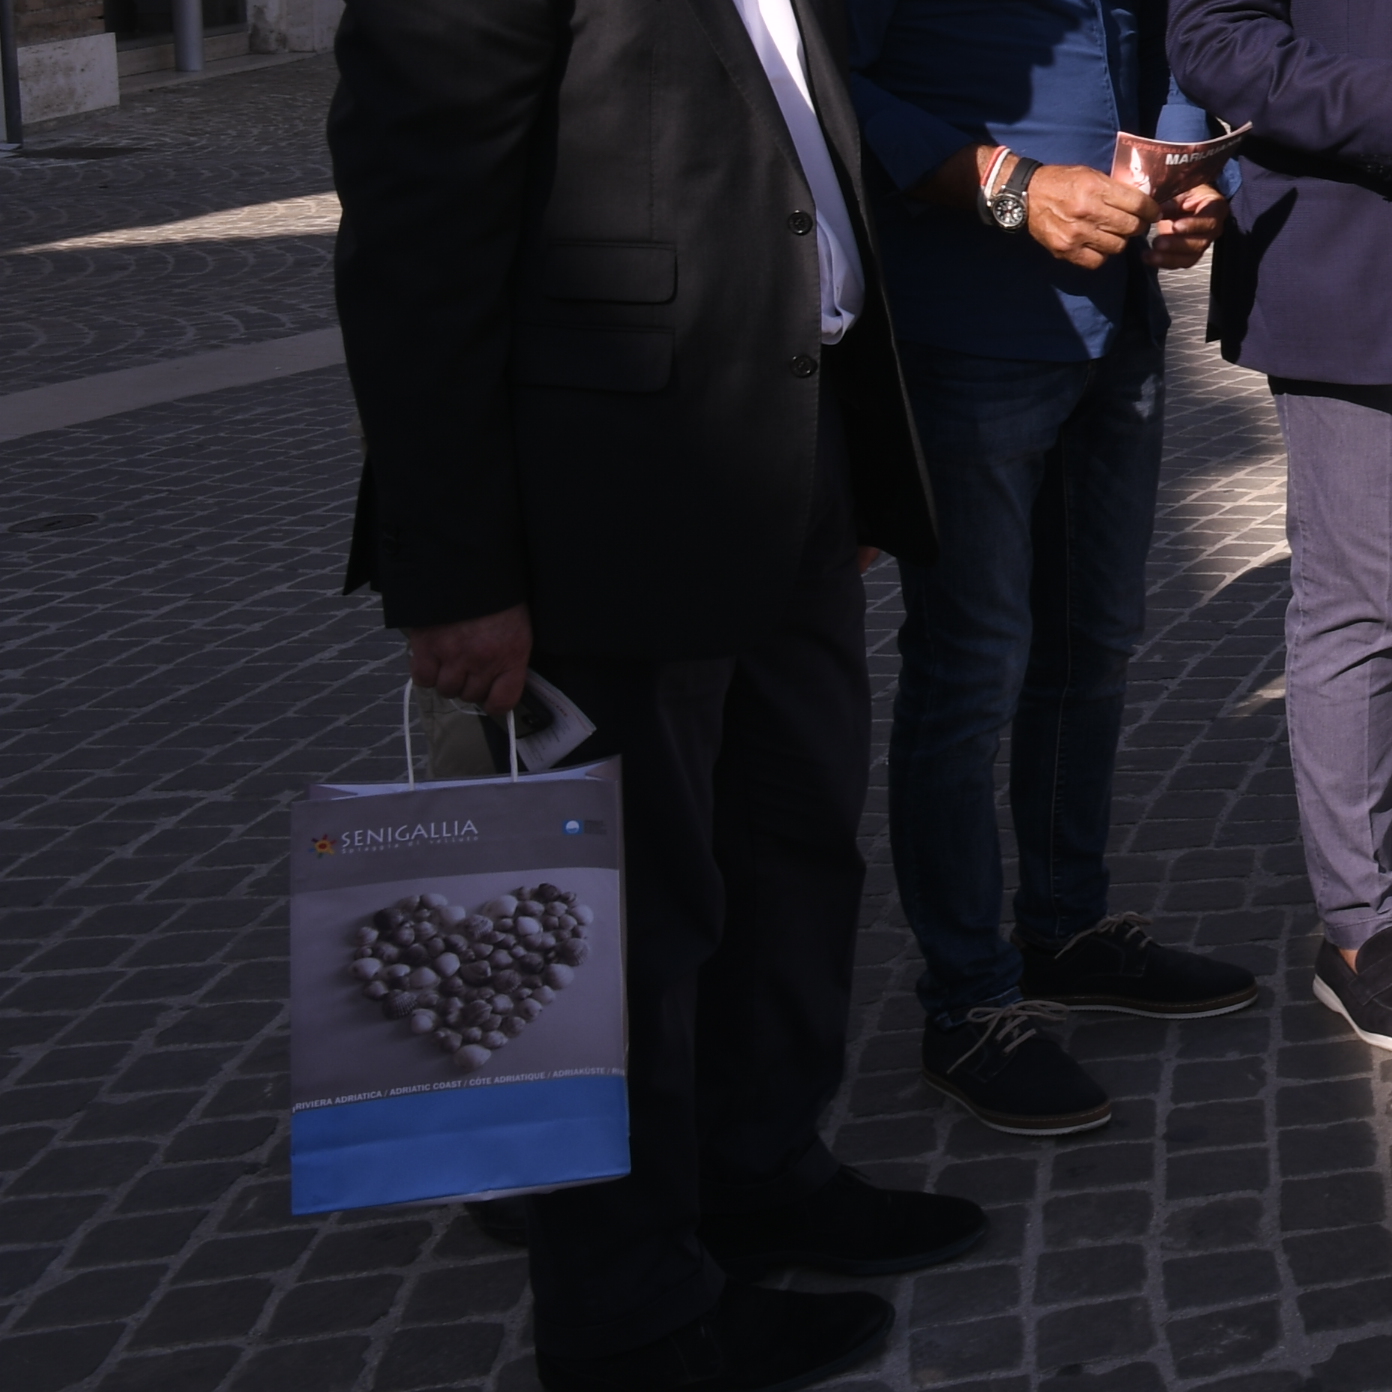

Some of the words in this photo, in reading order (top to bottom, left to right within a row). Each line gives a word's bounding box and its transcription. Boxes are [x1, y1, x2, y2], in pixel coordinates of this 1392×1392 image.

[1165, 136, 1242, 165] MARIJUANA
[341, 819, 478, 848] SENIGALLIA
[296, 1098, 333, 1110] RIVIERA
[335, 1090, 382, 1105] ADRIATICA
[390, 1084, 432, 1096] ADRIATIC
[432, 1080, 463, 1091] COAST
[469, 1074, 492, 1086] CÔTE
[494, 1071, 546, 1084] ADRIATIQUE
[552, 1066, 605, 1078] ADRIAKÜSTE
